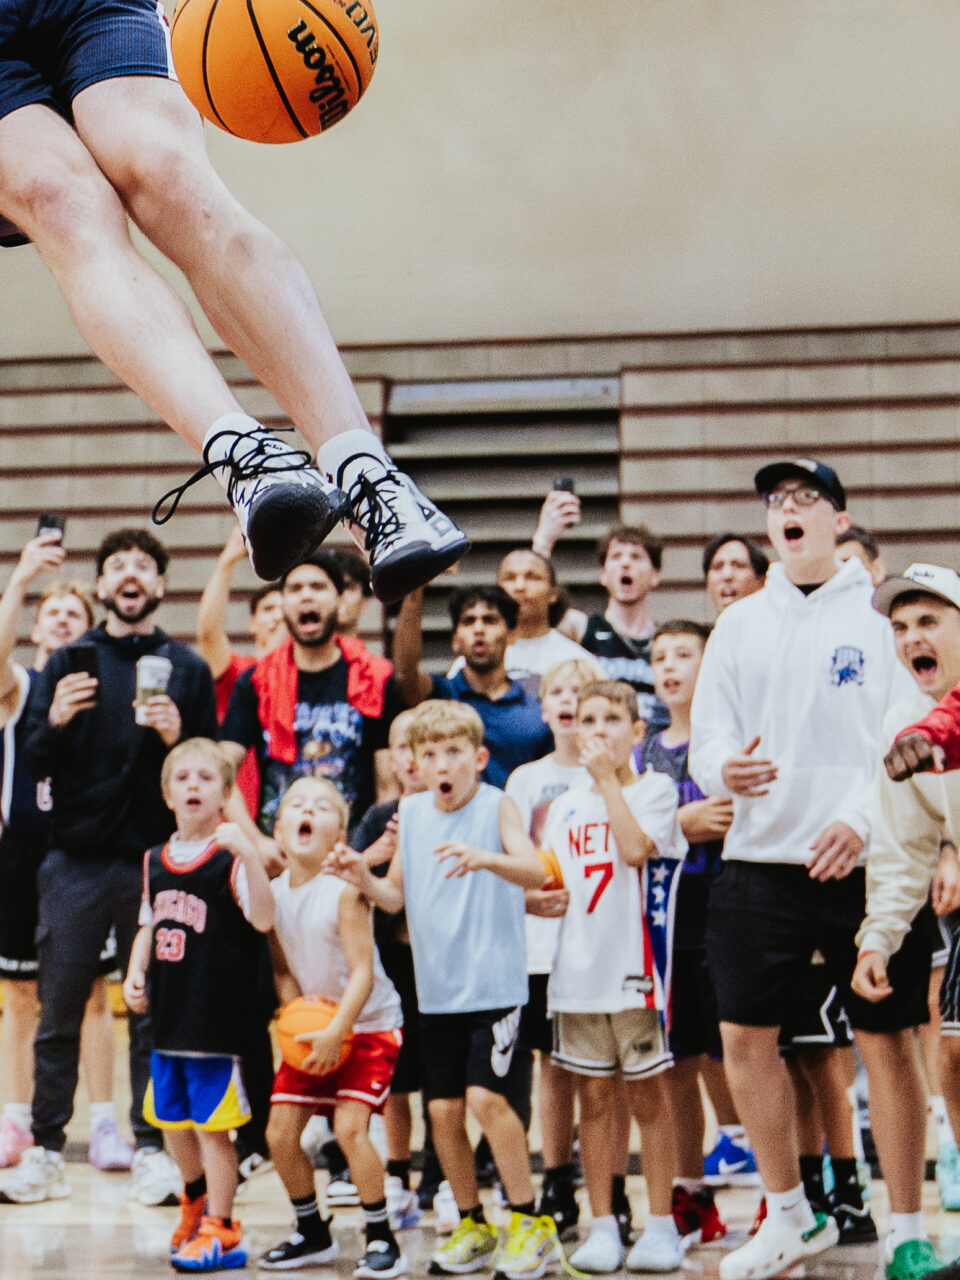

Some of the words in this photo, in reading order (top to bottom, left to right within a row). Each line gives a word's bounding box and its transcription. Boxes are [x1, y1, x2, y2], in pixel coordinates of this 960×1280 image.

[288, 17, 350, 132] Wilson
[584, 861, 614, 915] 7
[155, 927, 187, 962] 23
